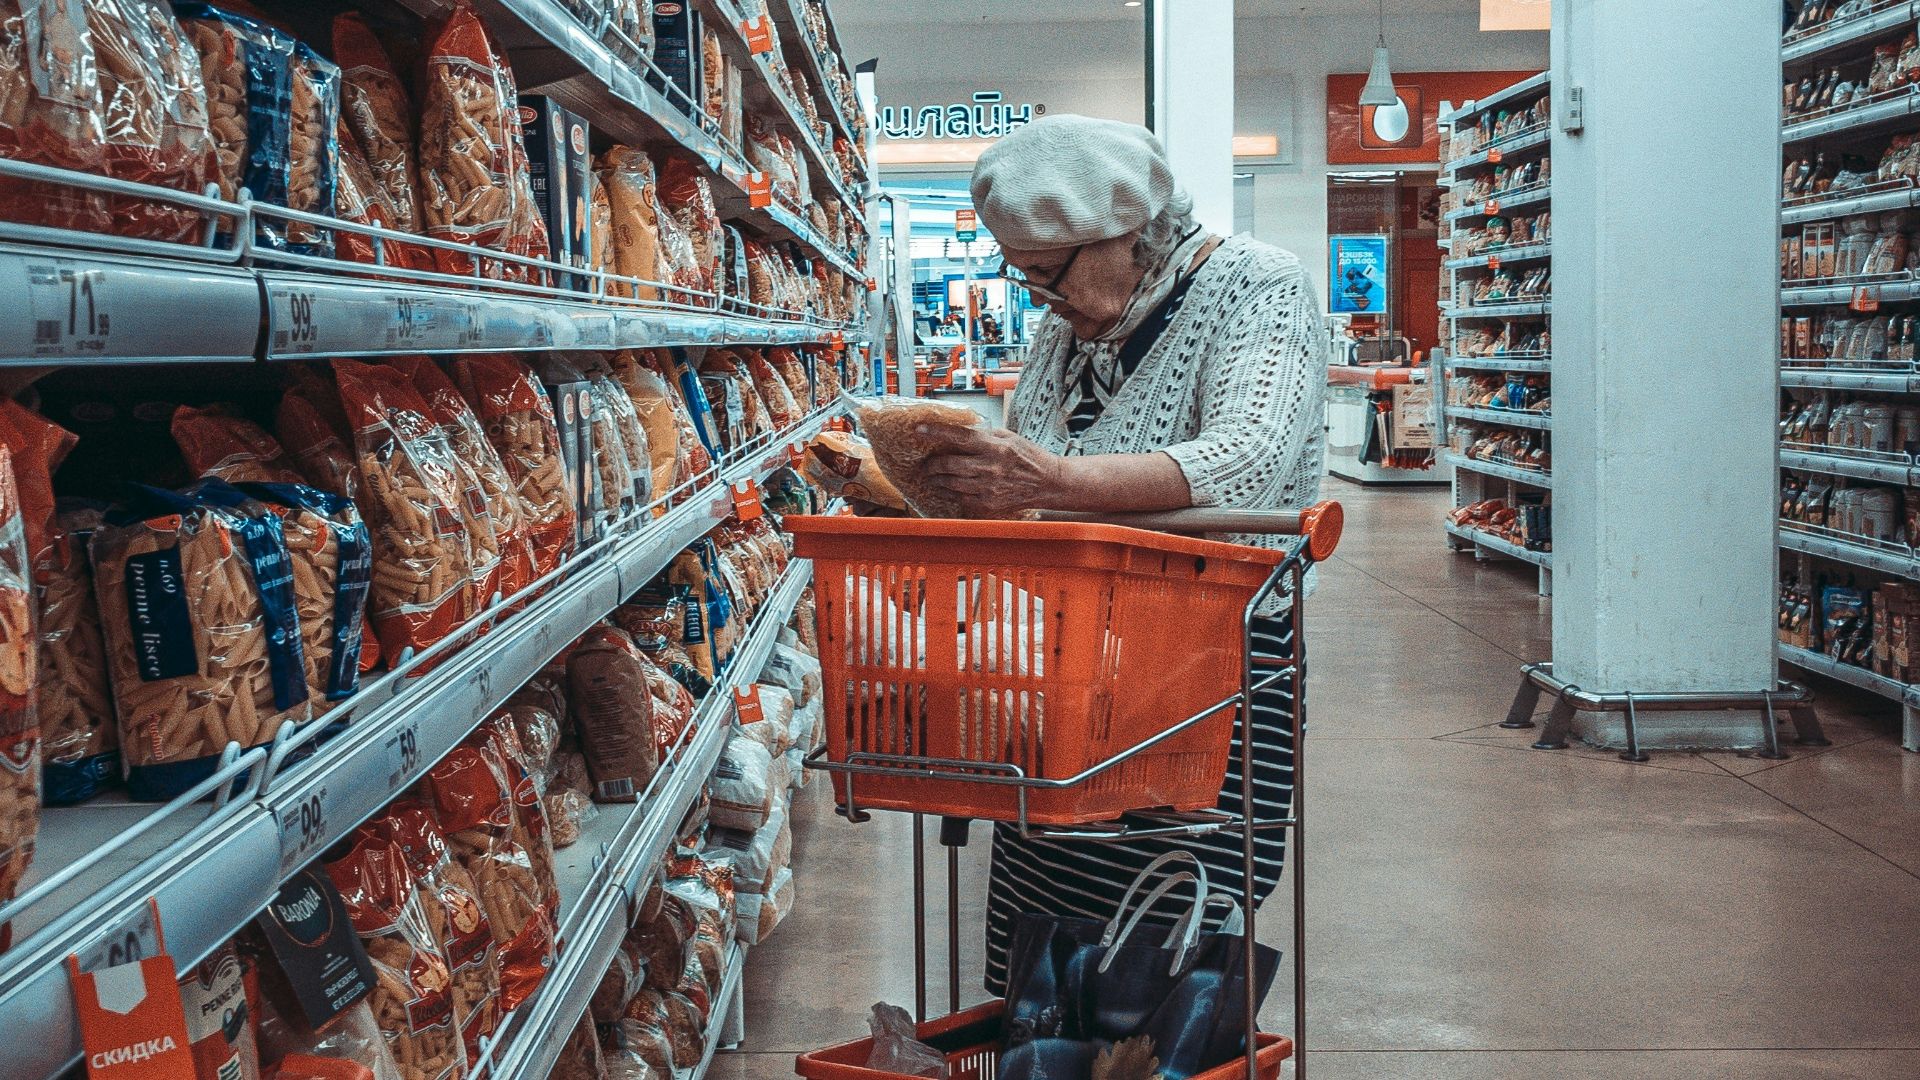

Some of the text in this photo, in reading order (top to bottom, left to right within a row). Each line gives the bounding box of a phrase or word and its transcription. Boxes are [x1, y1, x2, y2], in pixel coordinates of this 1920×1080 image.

[875, 91, 1032, 139] илайн
[61, 269, 97, 335] 71
[290, 293, 311, 341] 99
[130, 562, 161, 677] penne lisce
[399, 728, 416, 774] 59
[300, 795, 321, 852] 99
[91, 1035, 177, 1069] СКИДКА
